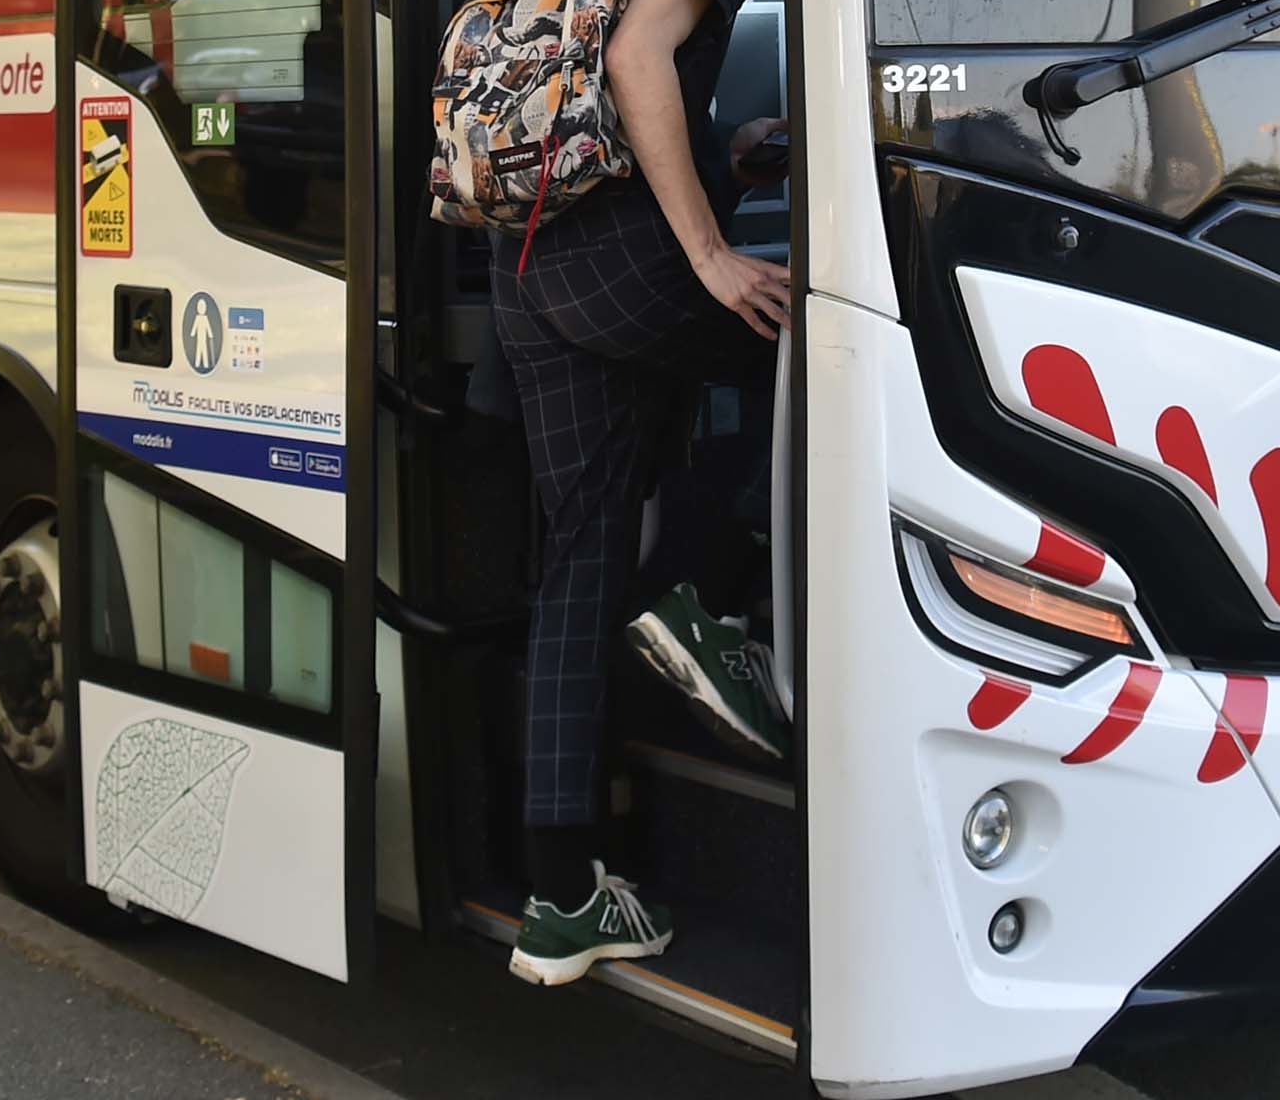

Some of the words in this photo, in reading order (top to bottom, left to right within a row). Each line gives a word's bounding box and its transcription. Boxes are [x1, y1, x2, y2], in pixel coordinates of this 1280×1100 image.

[883, 63, 967, 93] 3221
[82, 101, 129, 116] ATTENTION
[88, 210, 125, 225] ANGLES
[89, 228, 124, 243] MORTS
[233, 400, 253, 417] VOS
[132, 433, 173, 449] modalis.fr
